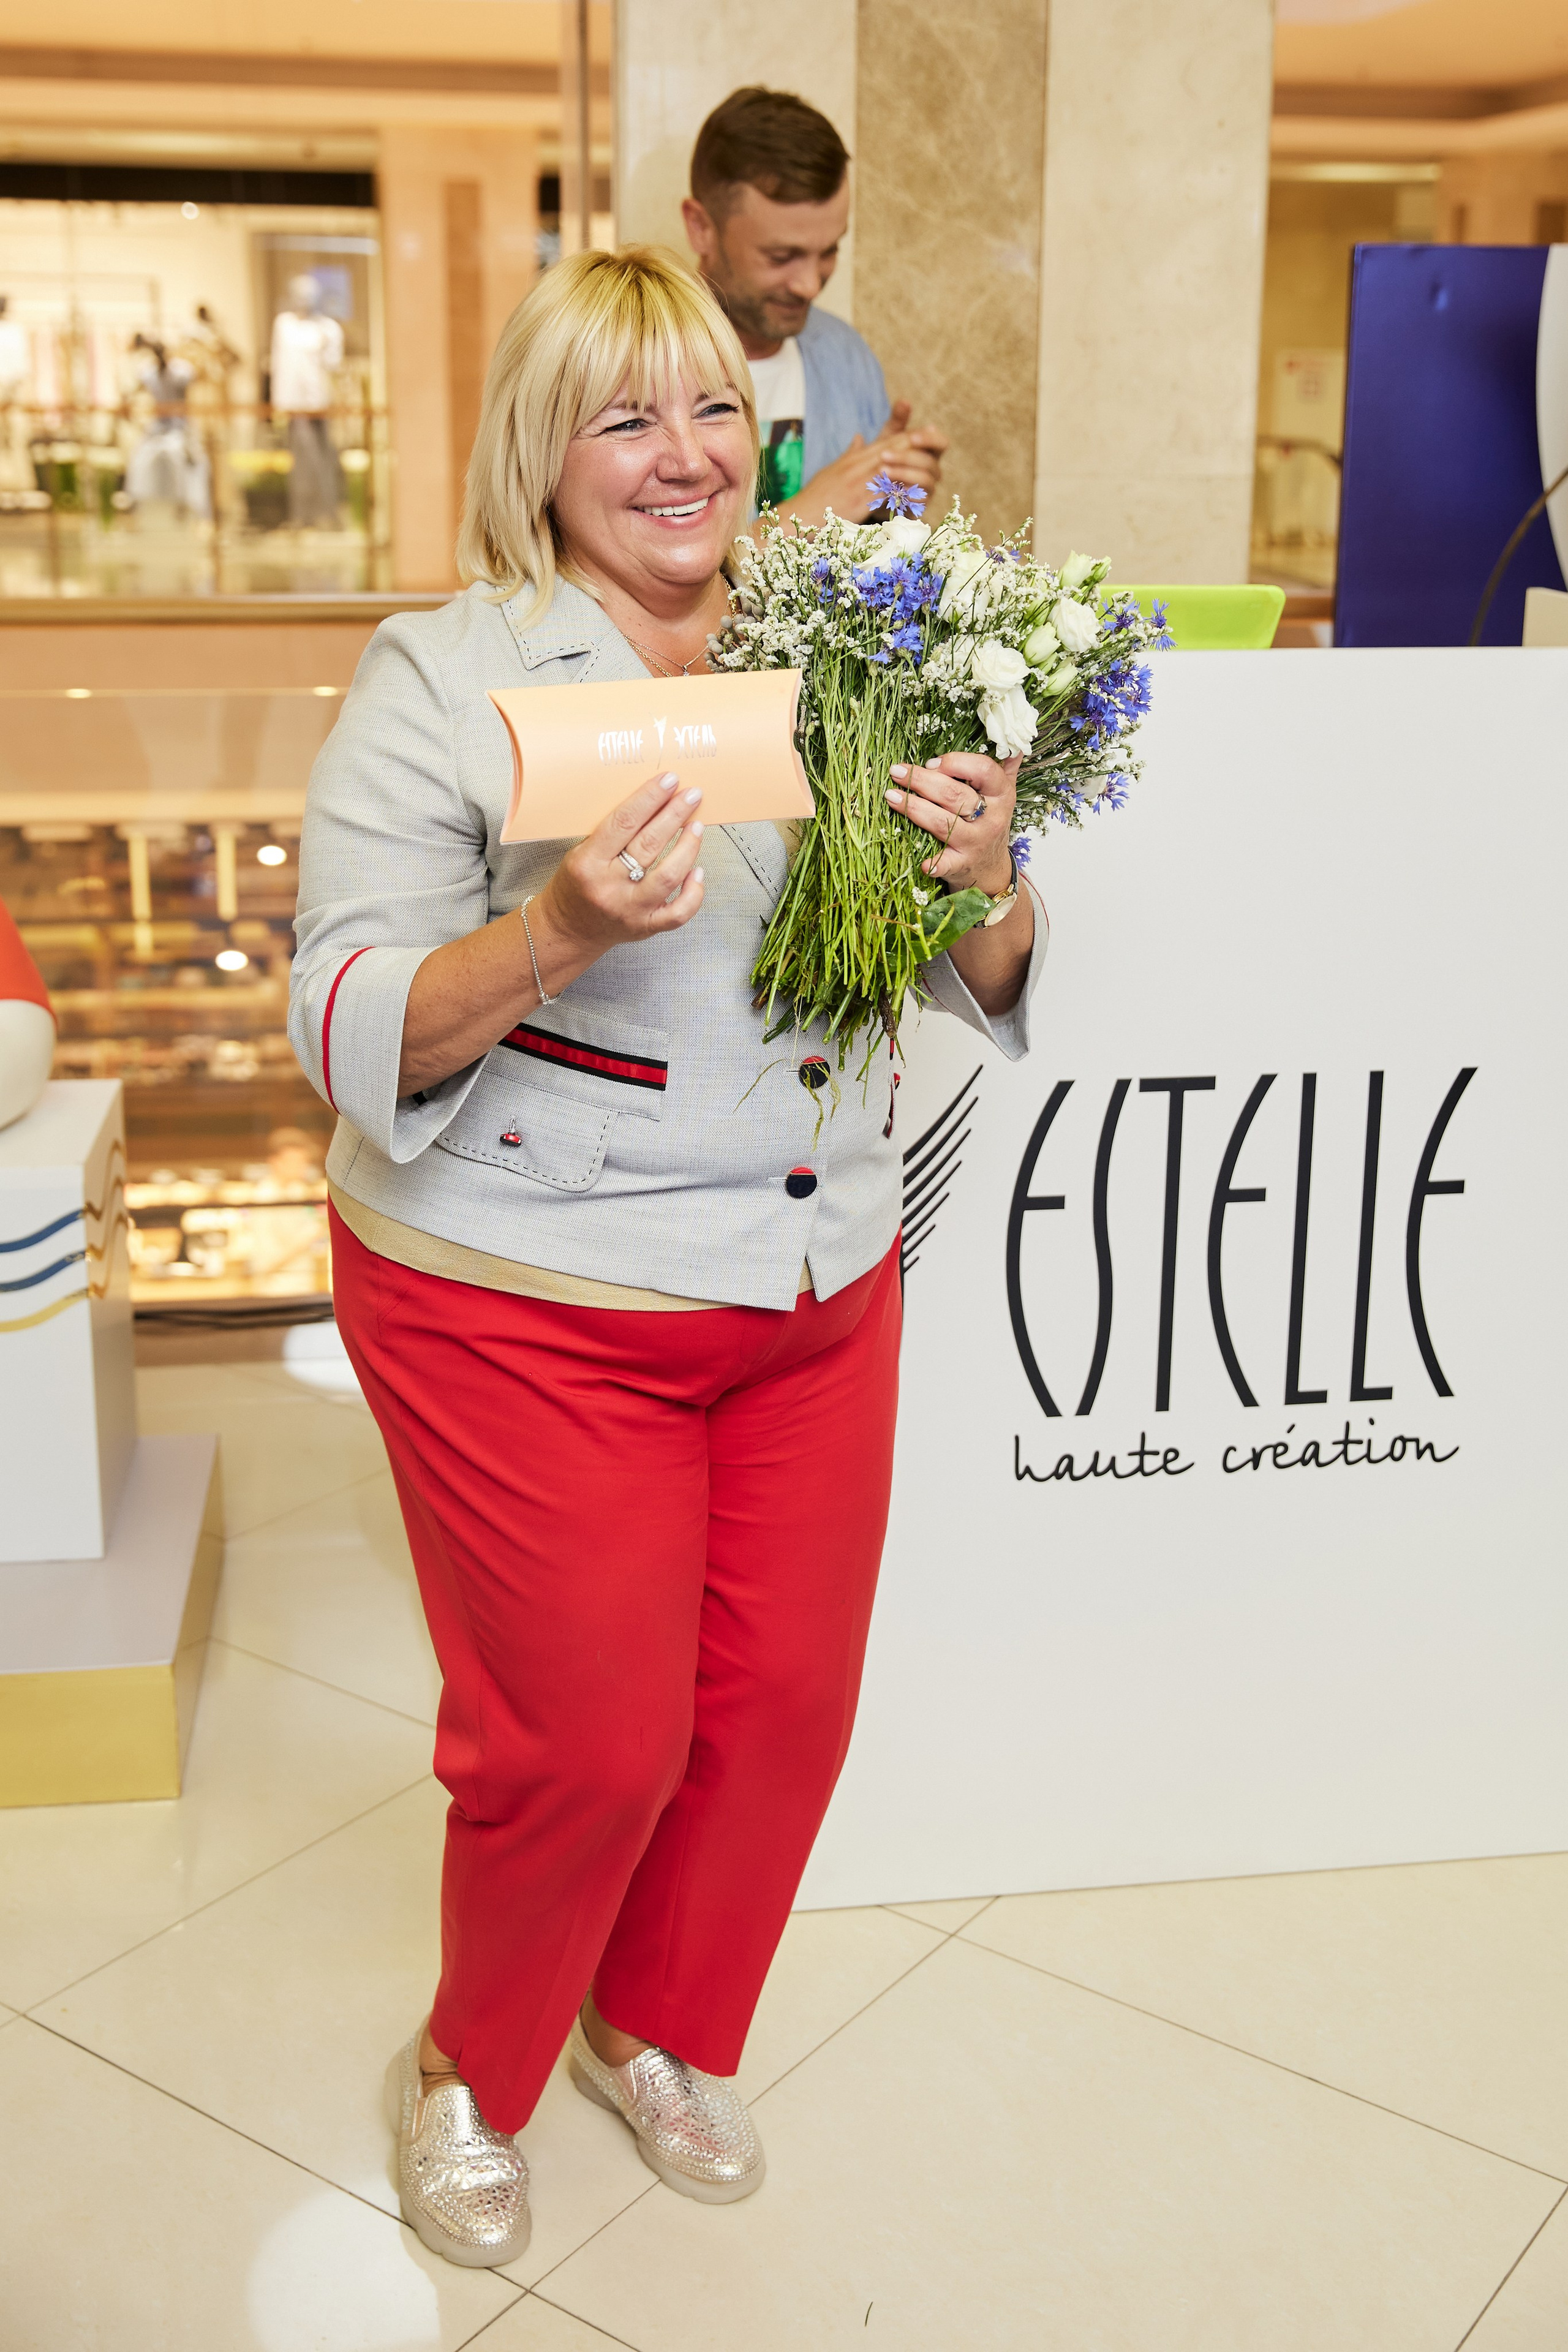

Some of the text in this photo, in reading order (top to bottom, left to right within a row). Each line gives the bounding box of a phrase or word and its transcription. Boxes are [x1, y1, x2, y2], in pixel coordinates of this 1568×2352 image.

[1006, 1067, 1478, 1417] ESTELLE
[1015, 1418, 1460, 1482] haute création
